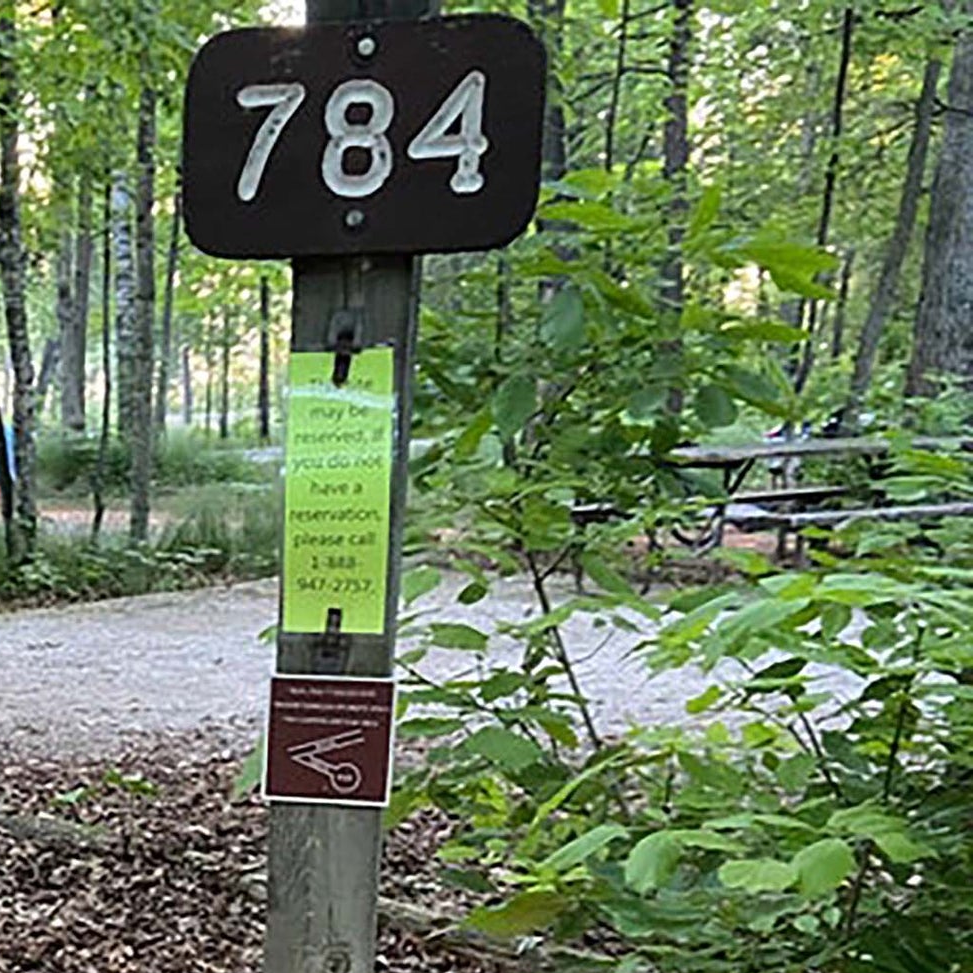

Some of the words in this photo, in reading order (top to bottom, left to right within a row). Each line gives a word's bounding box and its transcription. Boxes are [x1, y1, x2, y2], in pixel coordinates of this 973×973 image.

[237, 71, 488, 201] 784
[309, 407, 344, 421] may
[348, 403, 368, 416] be
[290, 459, 324, 473] you
[327, 456, 351, 468] do
[310, 481, 348, 494] have
[352, 484, 363, 494] a
[294, 534, 344, 548] please
[348, 532, 376, 545] call
